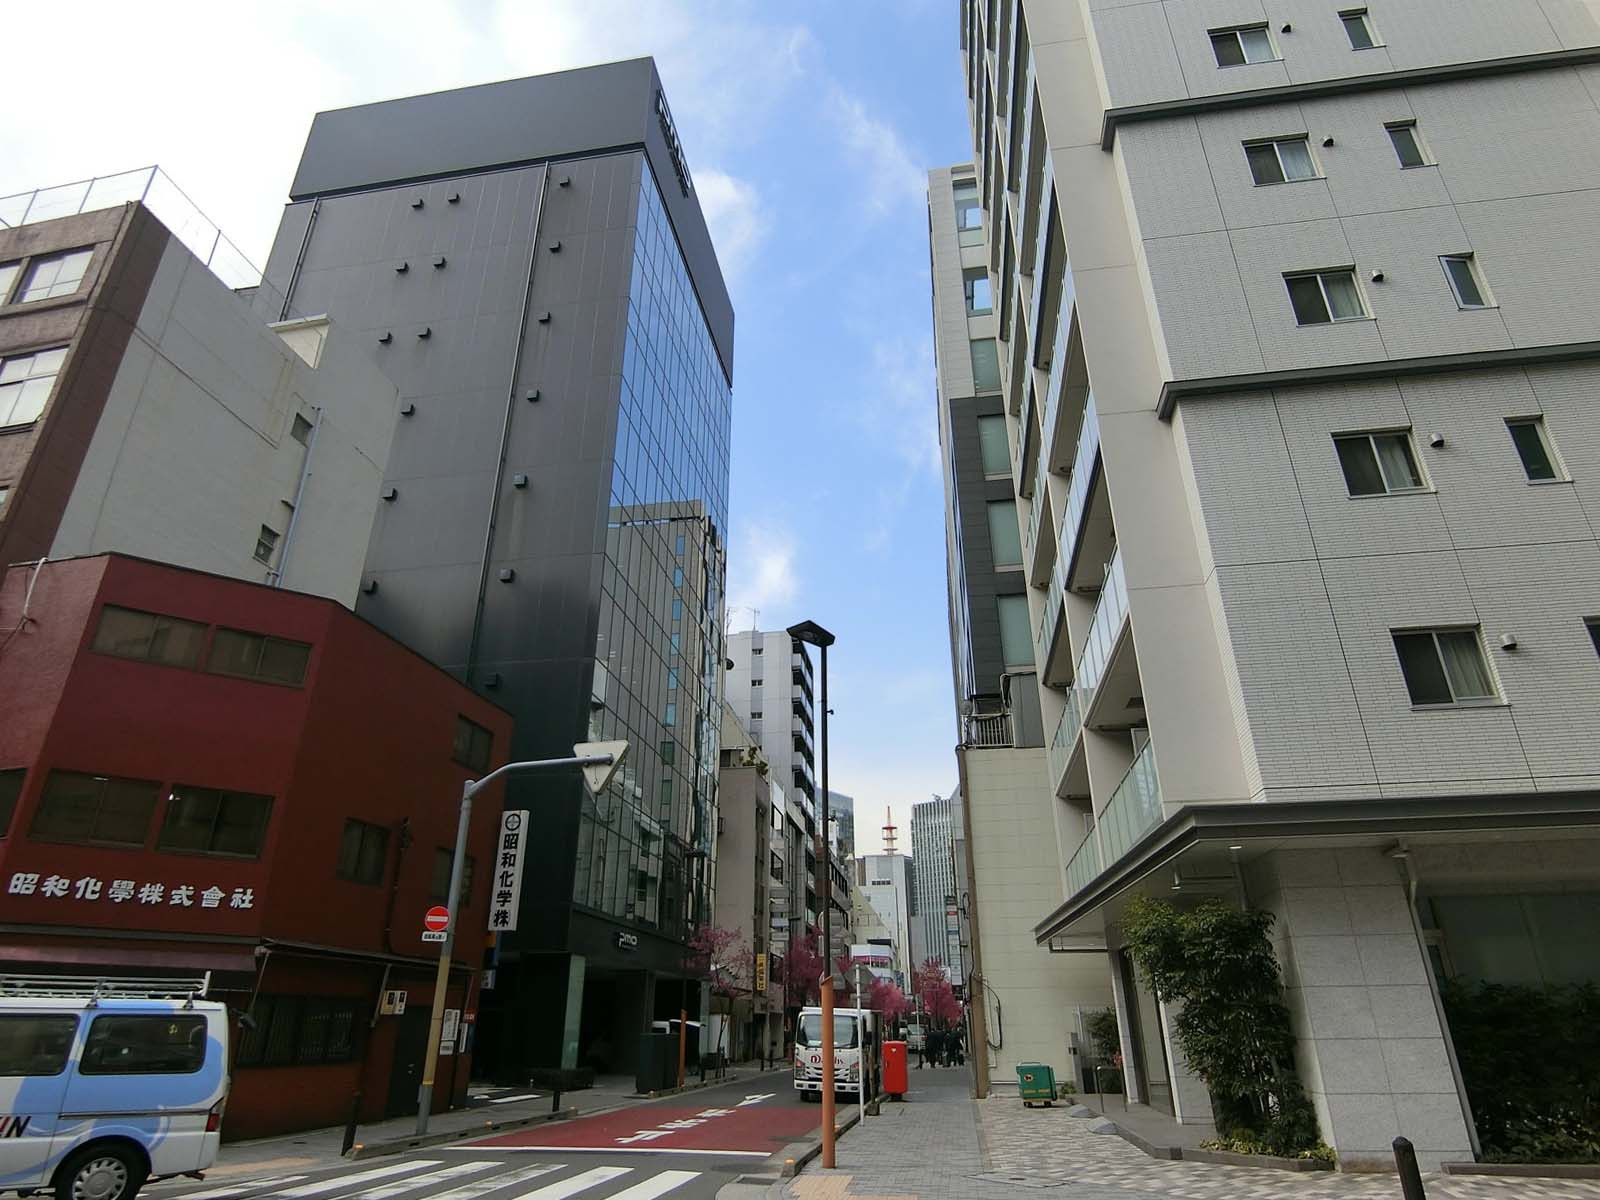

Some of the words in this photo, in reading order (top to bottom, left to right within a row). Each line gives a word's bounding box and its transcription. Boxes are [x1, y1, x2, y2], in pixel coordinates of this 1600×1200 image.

[8, 872, 254, 909] 昭和化學株式會社
[493, 833, 519, 927] 昭和化学株
[618, 932, 638, 948] pmo
